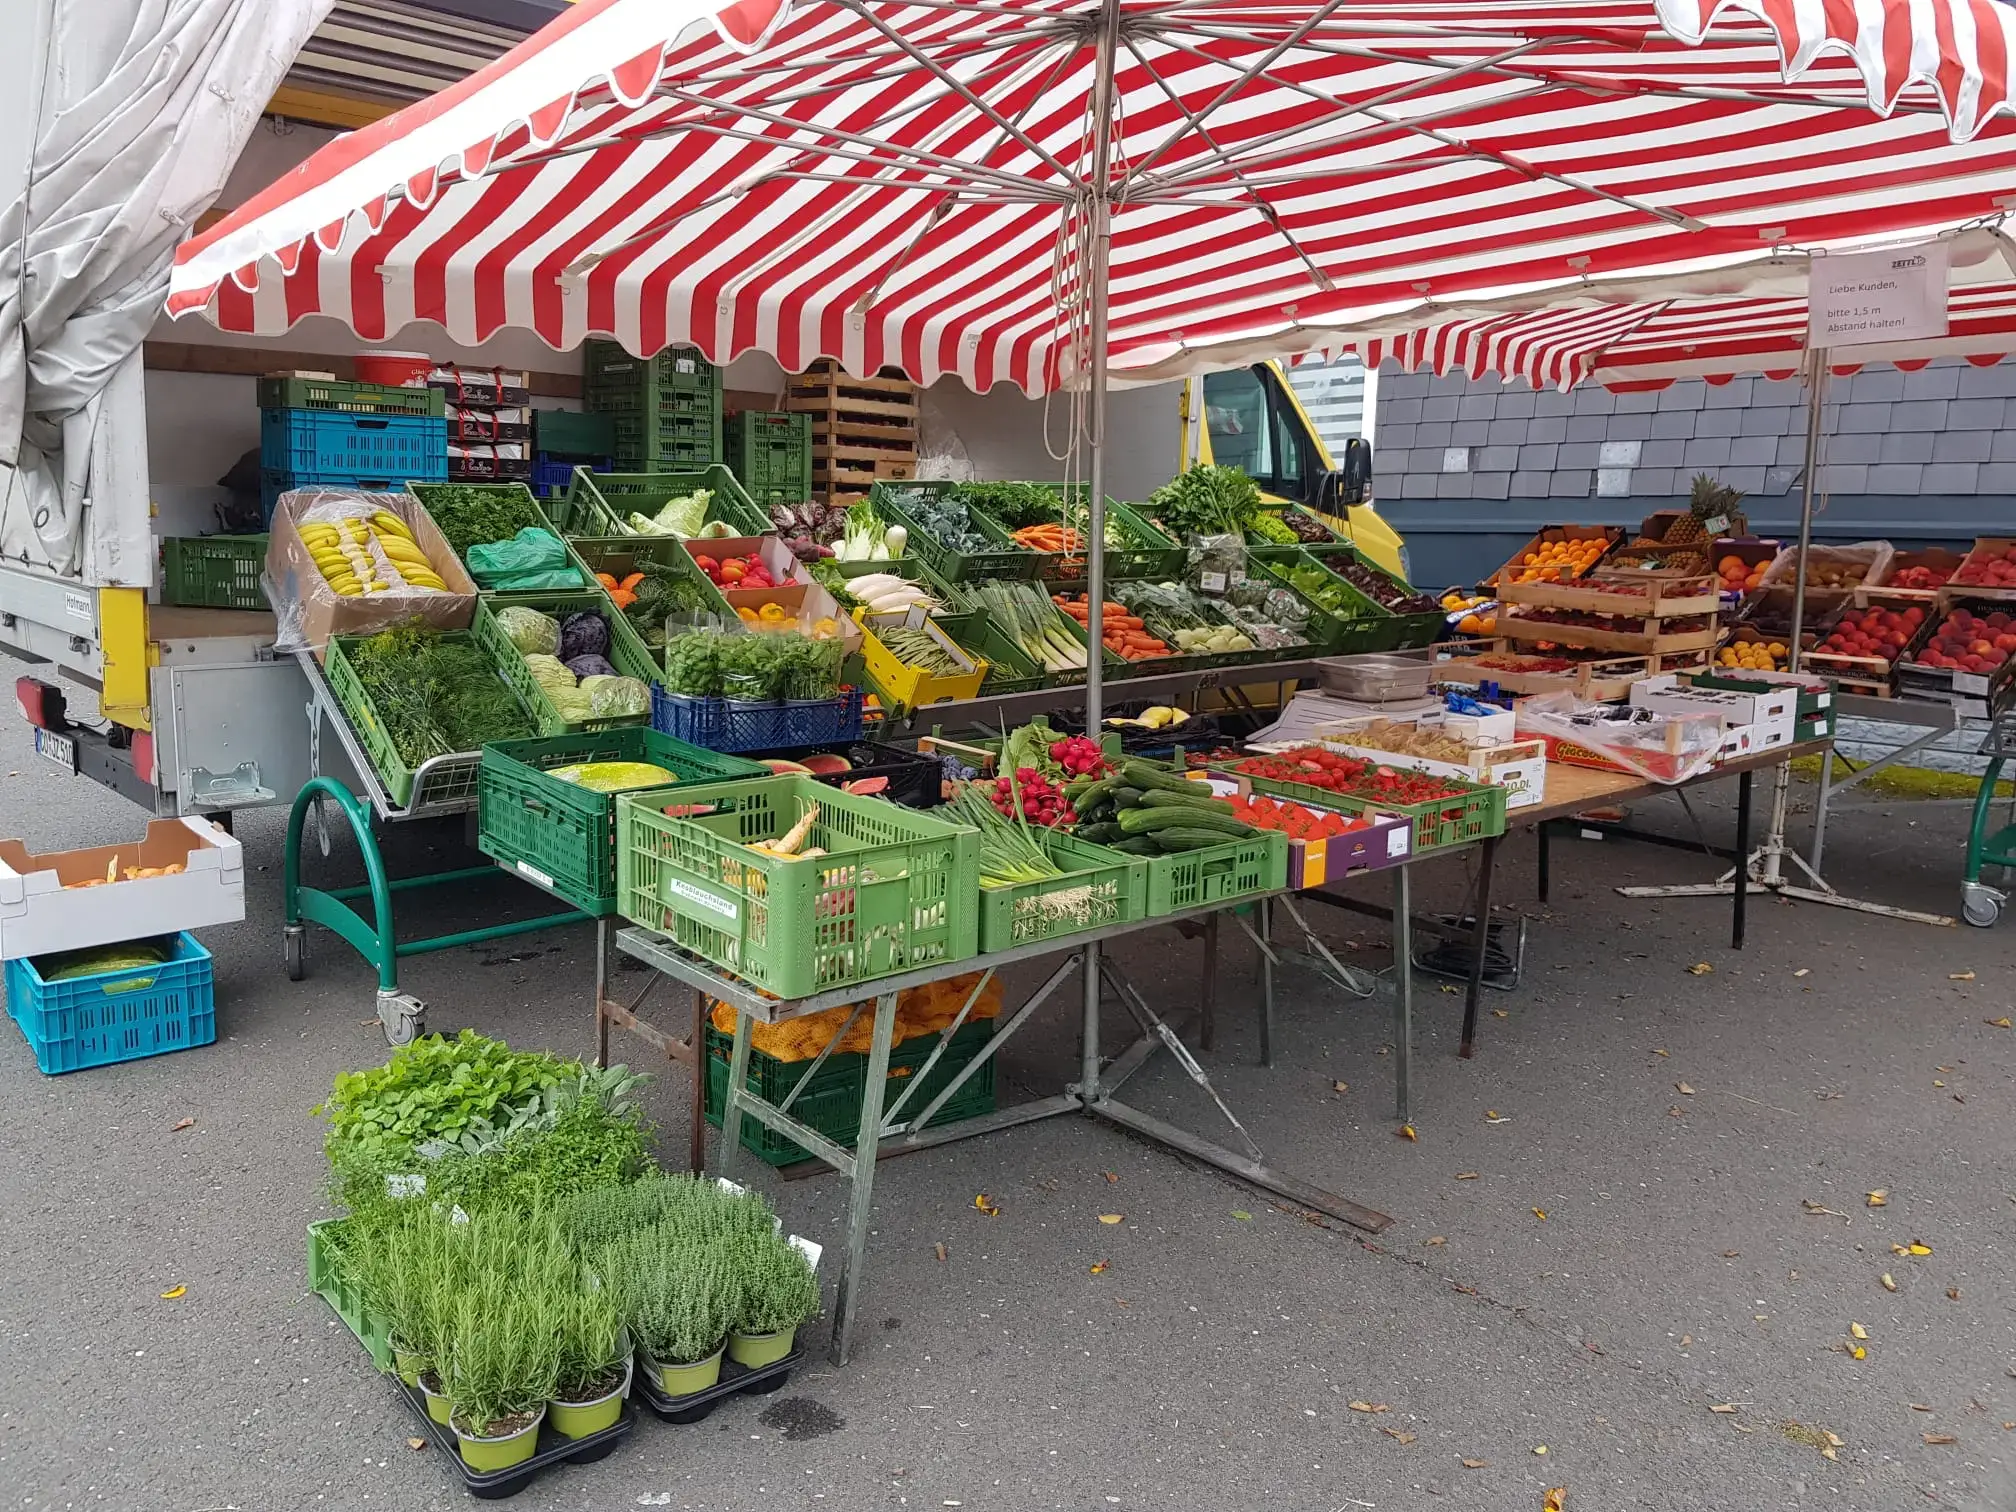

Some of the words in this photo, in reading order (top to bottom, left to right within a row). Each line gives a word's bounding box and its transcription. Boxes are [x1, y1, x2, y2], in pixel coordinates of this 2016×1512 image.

[1829, 281, 1855, 294] Liebe
[1858, 279, 1898, 292] Kunden,
[1827, 307, 1850, 318] bitte
[1853, 306, 1869, 316] 1,5
[1871, 306, 1881, 315] m
[1827, 320, 1867, 333] Abstand
[1869, 317, 1905, 329] halten!
[60, 741, 73, 765] 510
